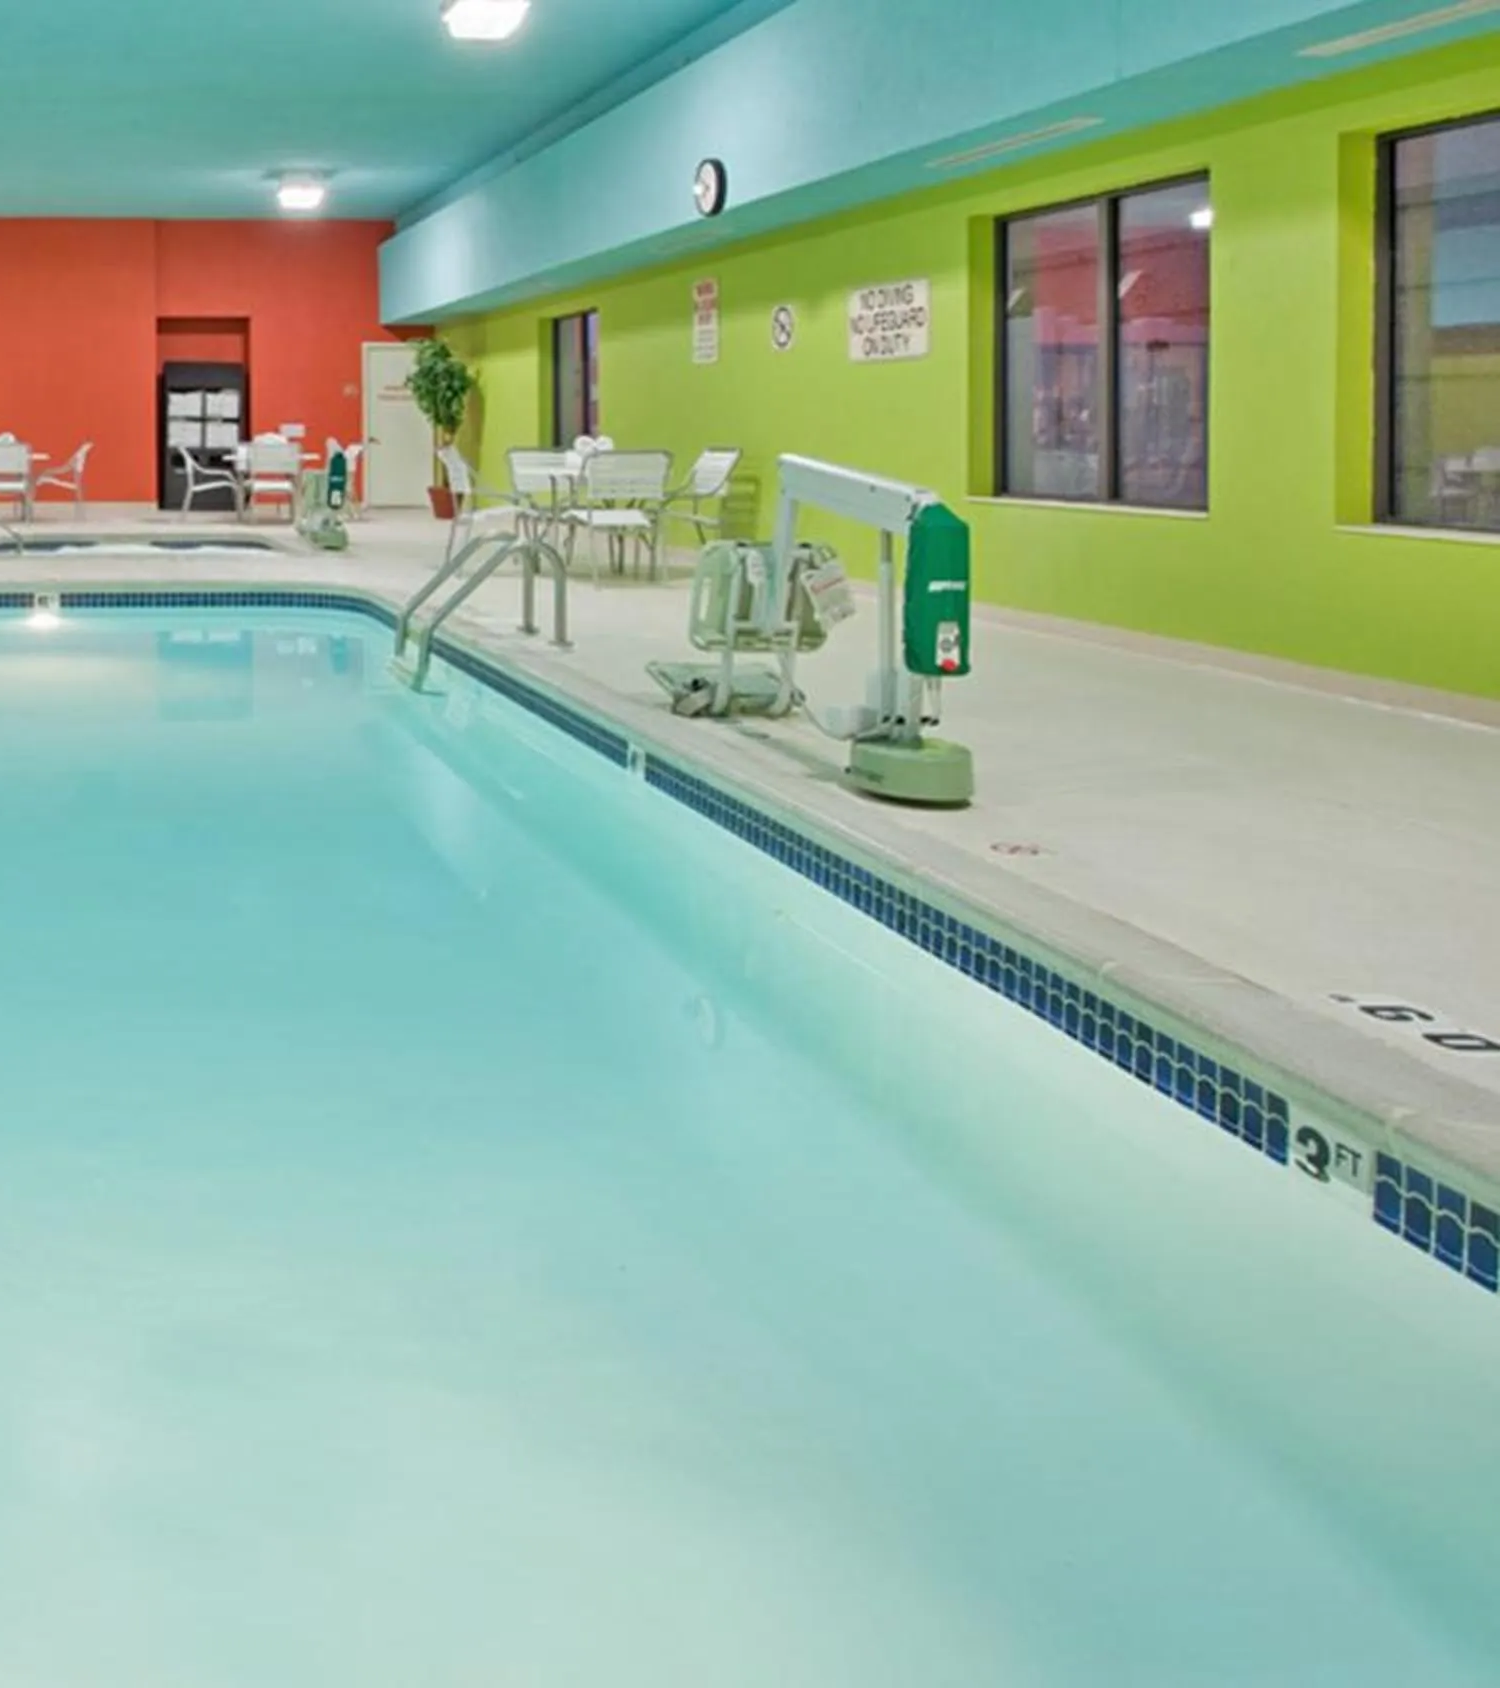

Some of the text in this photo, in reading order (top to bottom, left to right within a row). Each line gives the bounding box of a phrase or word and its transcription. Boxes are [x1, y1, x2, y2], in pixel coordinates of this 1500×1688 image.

[860, 283, 914, 311] NO DIVING
[862, 332, 911, 357] ON DUTY
[1294, 1125, 1362, 1184] 3 FT
